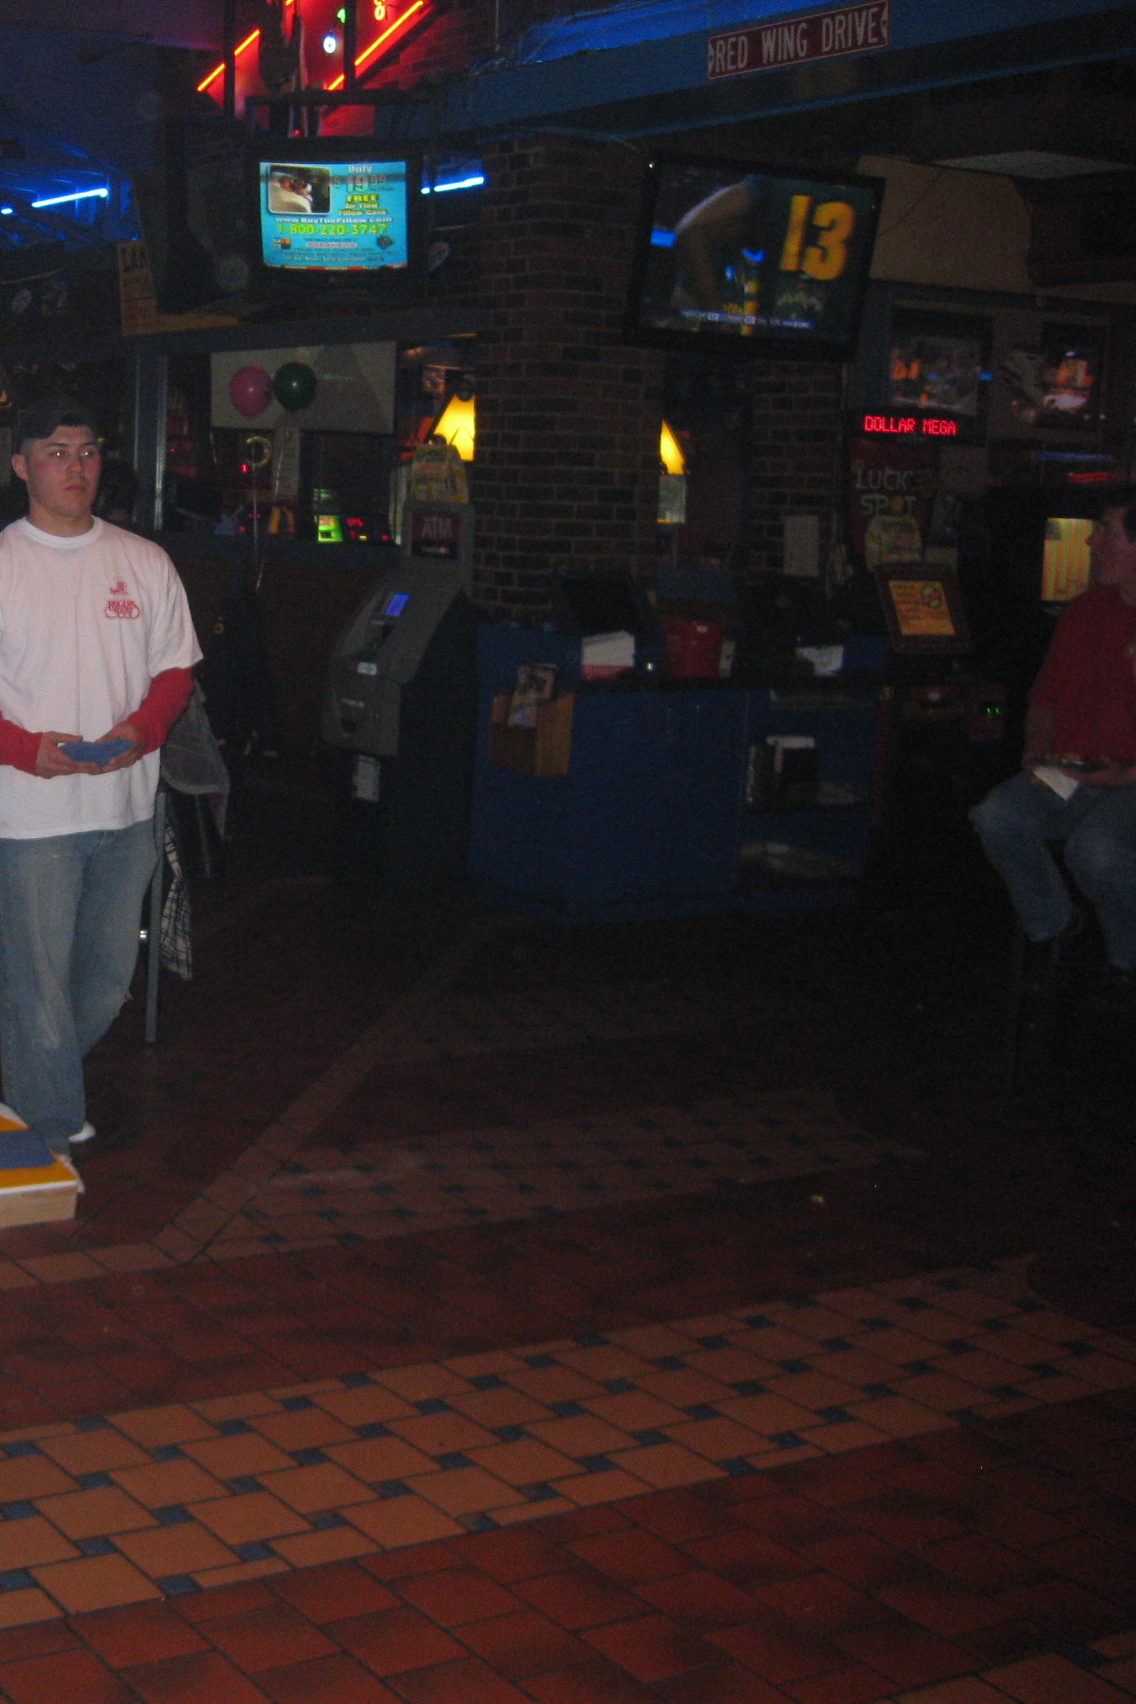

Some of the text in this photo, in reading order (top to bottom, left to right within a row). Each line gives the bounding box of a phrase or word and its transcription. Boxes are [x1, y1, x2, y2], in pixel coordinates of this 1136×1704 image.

[716, 7, 879, 72] RED WING DRIVE
[278, 224, 388, 235] 1-800-220-3747
[779, 195, 855, 281] 13
[864, 415, 957, 435] DOLLAR MEGA
[855, 466, 914, 491] LUCK
[422, 517, 452, 538] ATM
